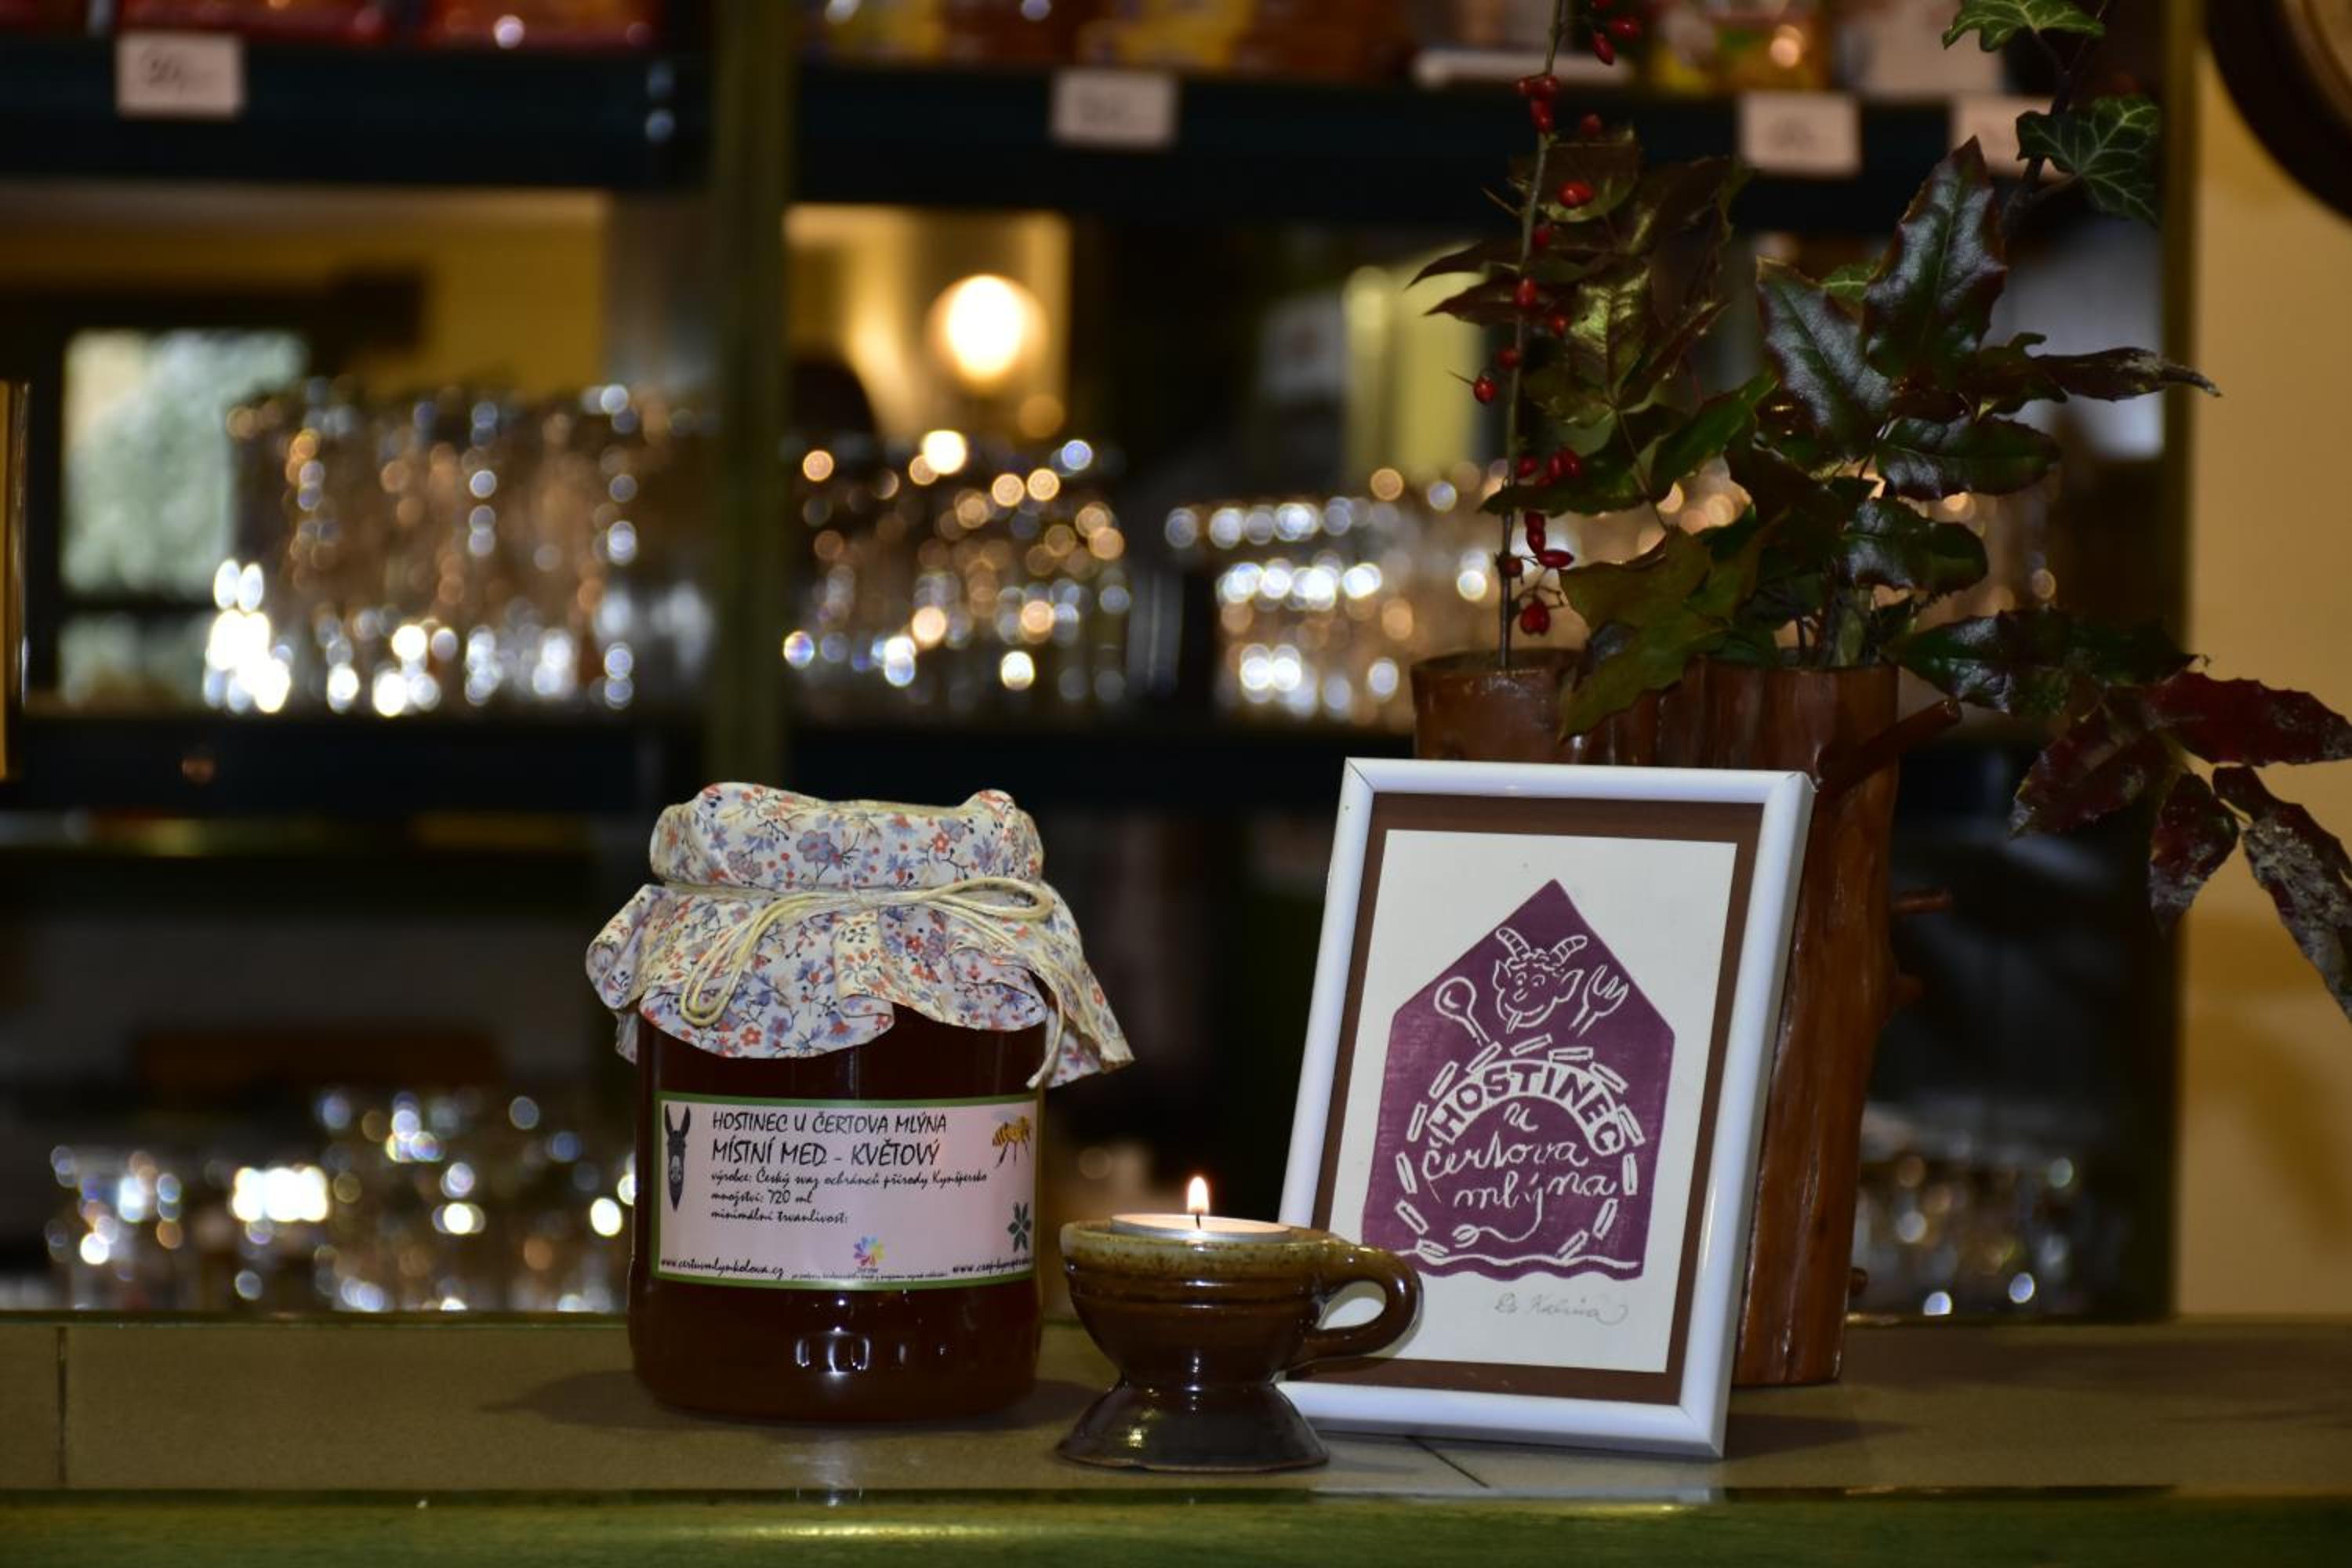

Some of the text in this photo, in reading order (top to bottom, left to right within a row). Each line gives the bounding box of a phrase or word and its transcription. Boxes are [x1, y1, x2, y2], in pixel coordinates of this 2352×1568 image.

[1428, 1061, 1625, 1156] HOSTINEC
[1503, 1102, 1538, 1131] u
[712, 1111, 947, 1134] HOSTINEC U ČERTOVA MLÝNA
[711, 1134, 776, 1164] MÍSTNÍ
[780, 1141, 828, 1167] MED
[851, 1138, 941, 1167] KVĚTOVÝ
[756, 1167, 790, 1189] Český
[883, 1171, 928, 1189] přírody
[768, 1189, 791, 1205] 720
[794, 1190, 813, 1204] ml
